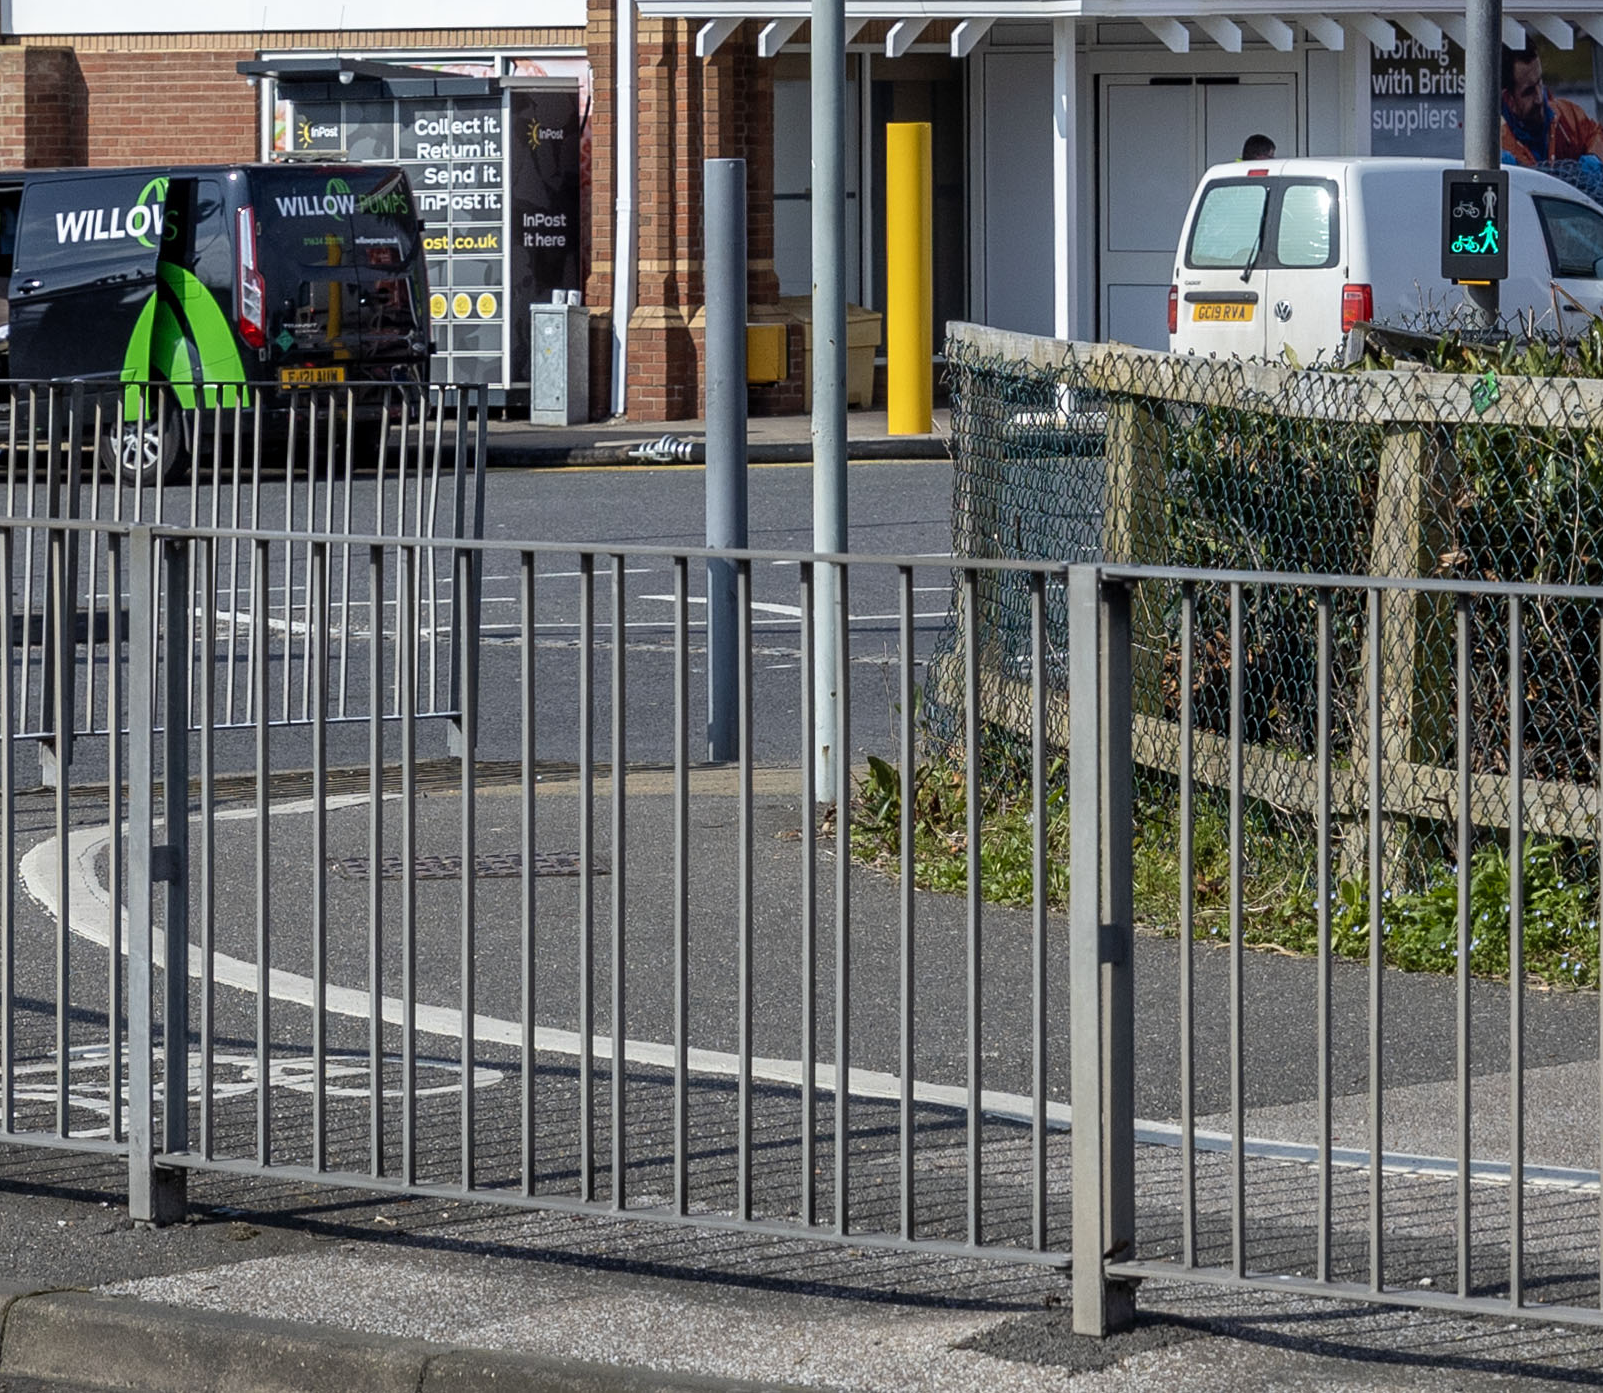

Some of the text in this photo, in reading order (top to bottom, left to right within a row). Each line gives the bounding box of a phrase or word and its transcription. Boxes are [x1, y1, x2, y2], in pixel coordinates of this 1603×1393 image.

[1372, 68, 1465, 94] with Britis
[311, 125, 338, 138] InPost
[414, 115, 501, 136] Collect it.
[538, 128, 563, 139] InPost
[417, 140, 501, 159] Return it.
[424, 165, 501, 184] Send it.
[275, 193, 409, 217] WILLOW PUMPS
[420, 193, 501, 210] InPost it.
[523, 213, 566, 227] InPost
[423, 234, 498, 250] ost.co.uk
[523, 232, 566, 247] it here
[1198, 305, 1246, 320] GC19 RVA
